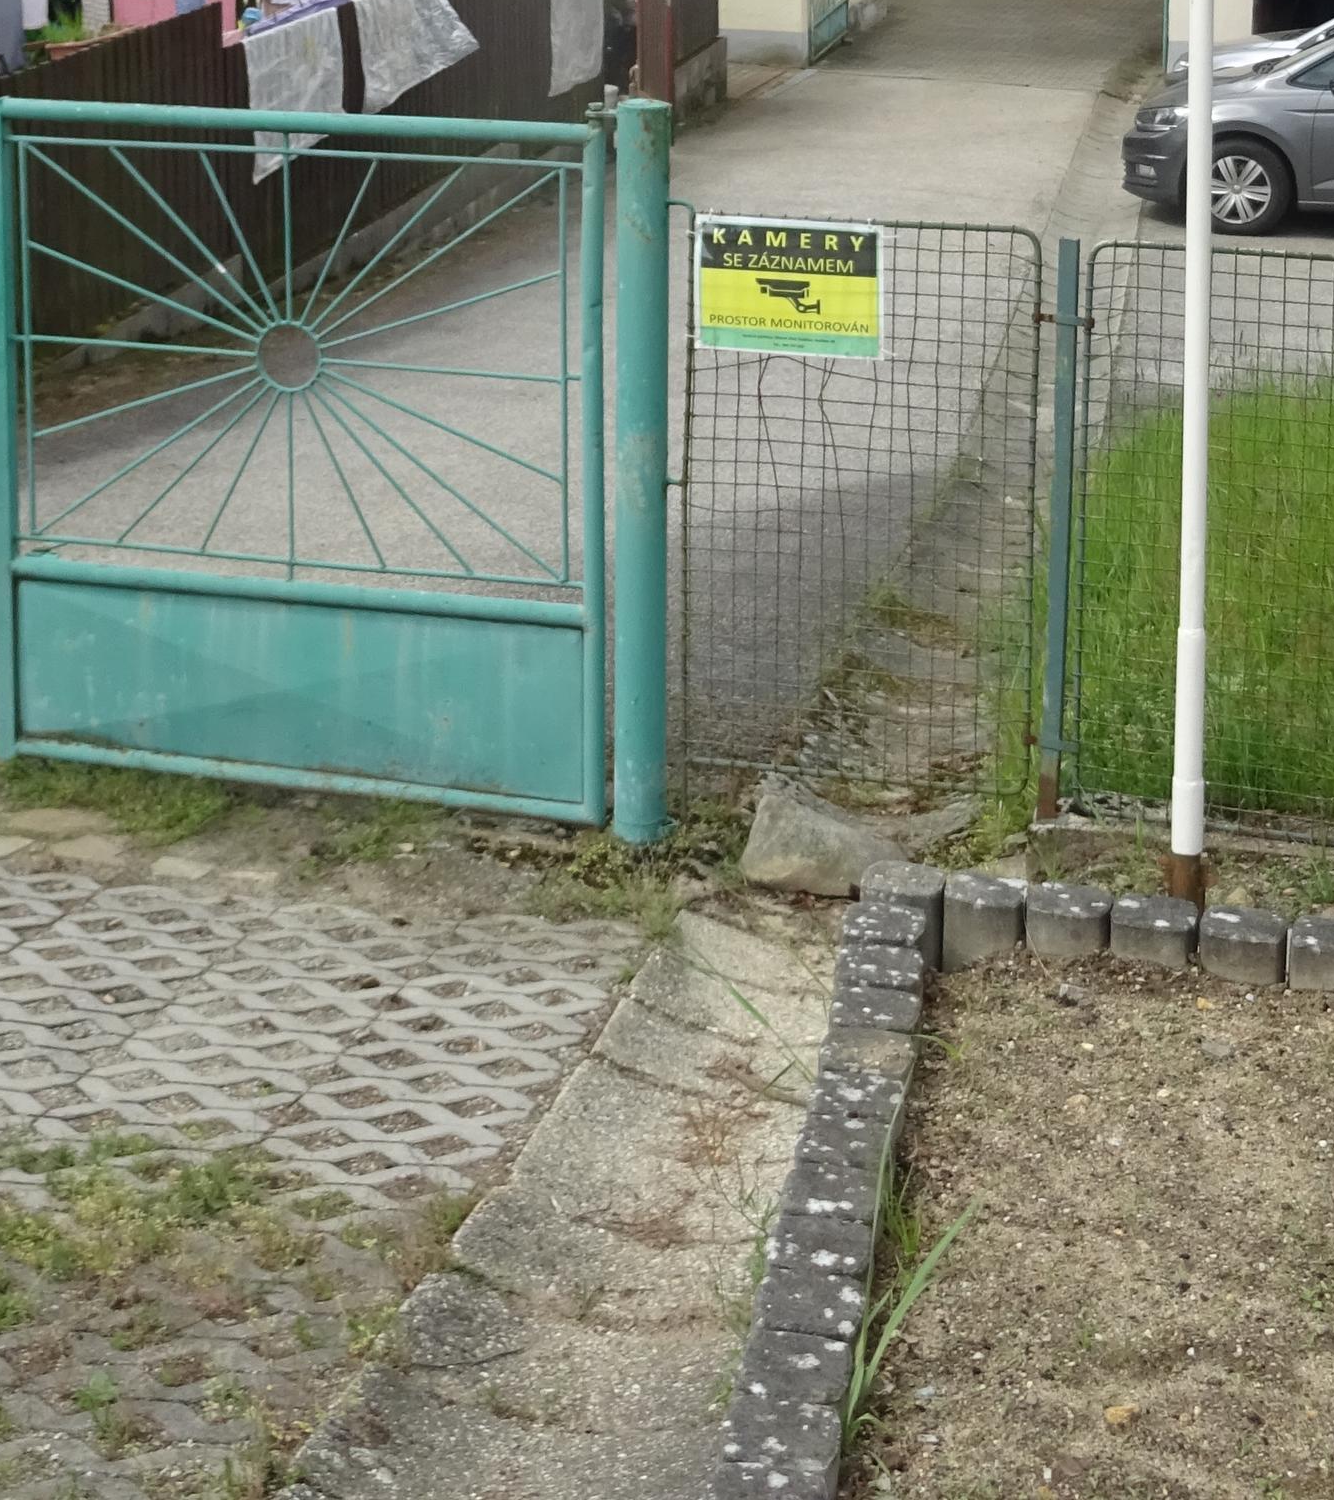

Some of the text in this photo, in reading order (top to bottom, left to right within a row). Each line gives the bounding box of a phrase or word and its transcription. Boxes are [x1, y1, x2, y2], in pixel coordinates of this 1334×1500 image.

[712, 227, 865, 252] KAMERY
[723, 252, 854, 274] SE ZÁZNAMEM
[709, 313, 869, 334] PROSTOR MONITOROVÁN
